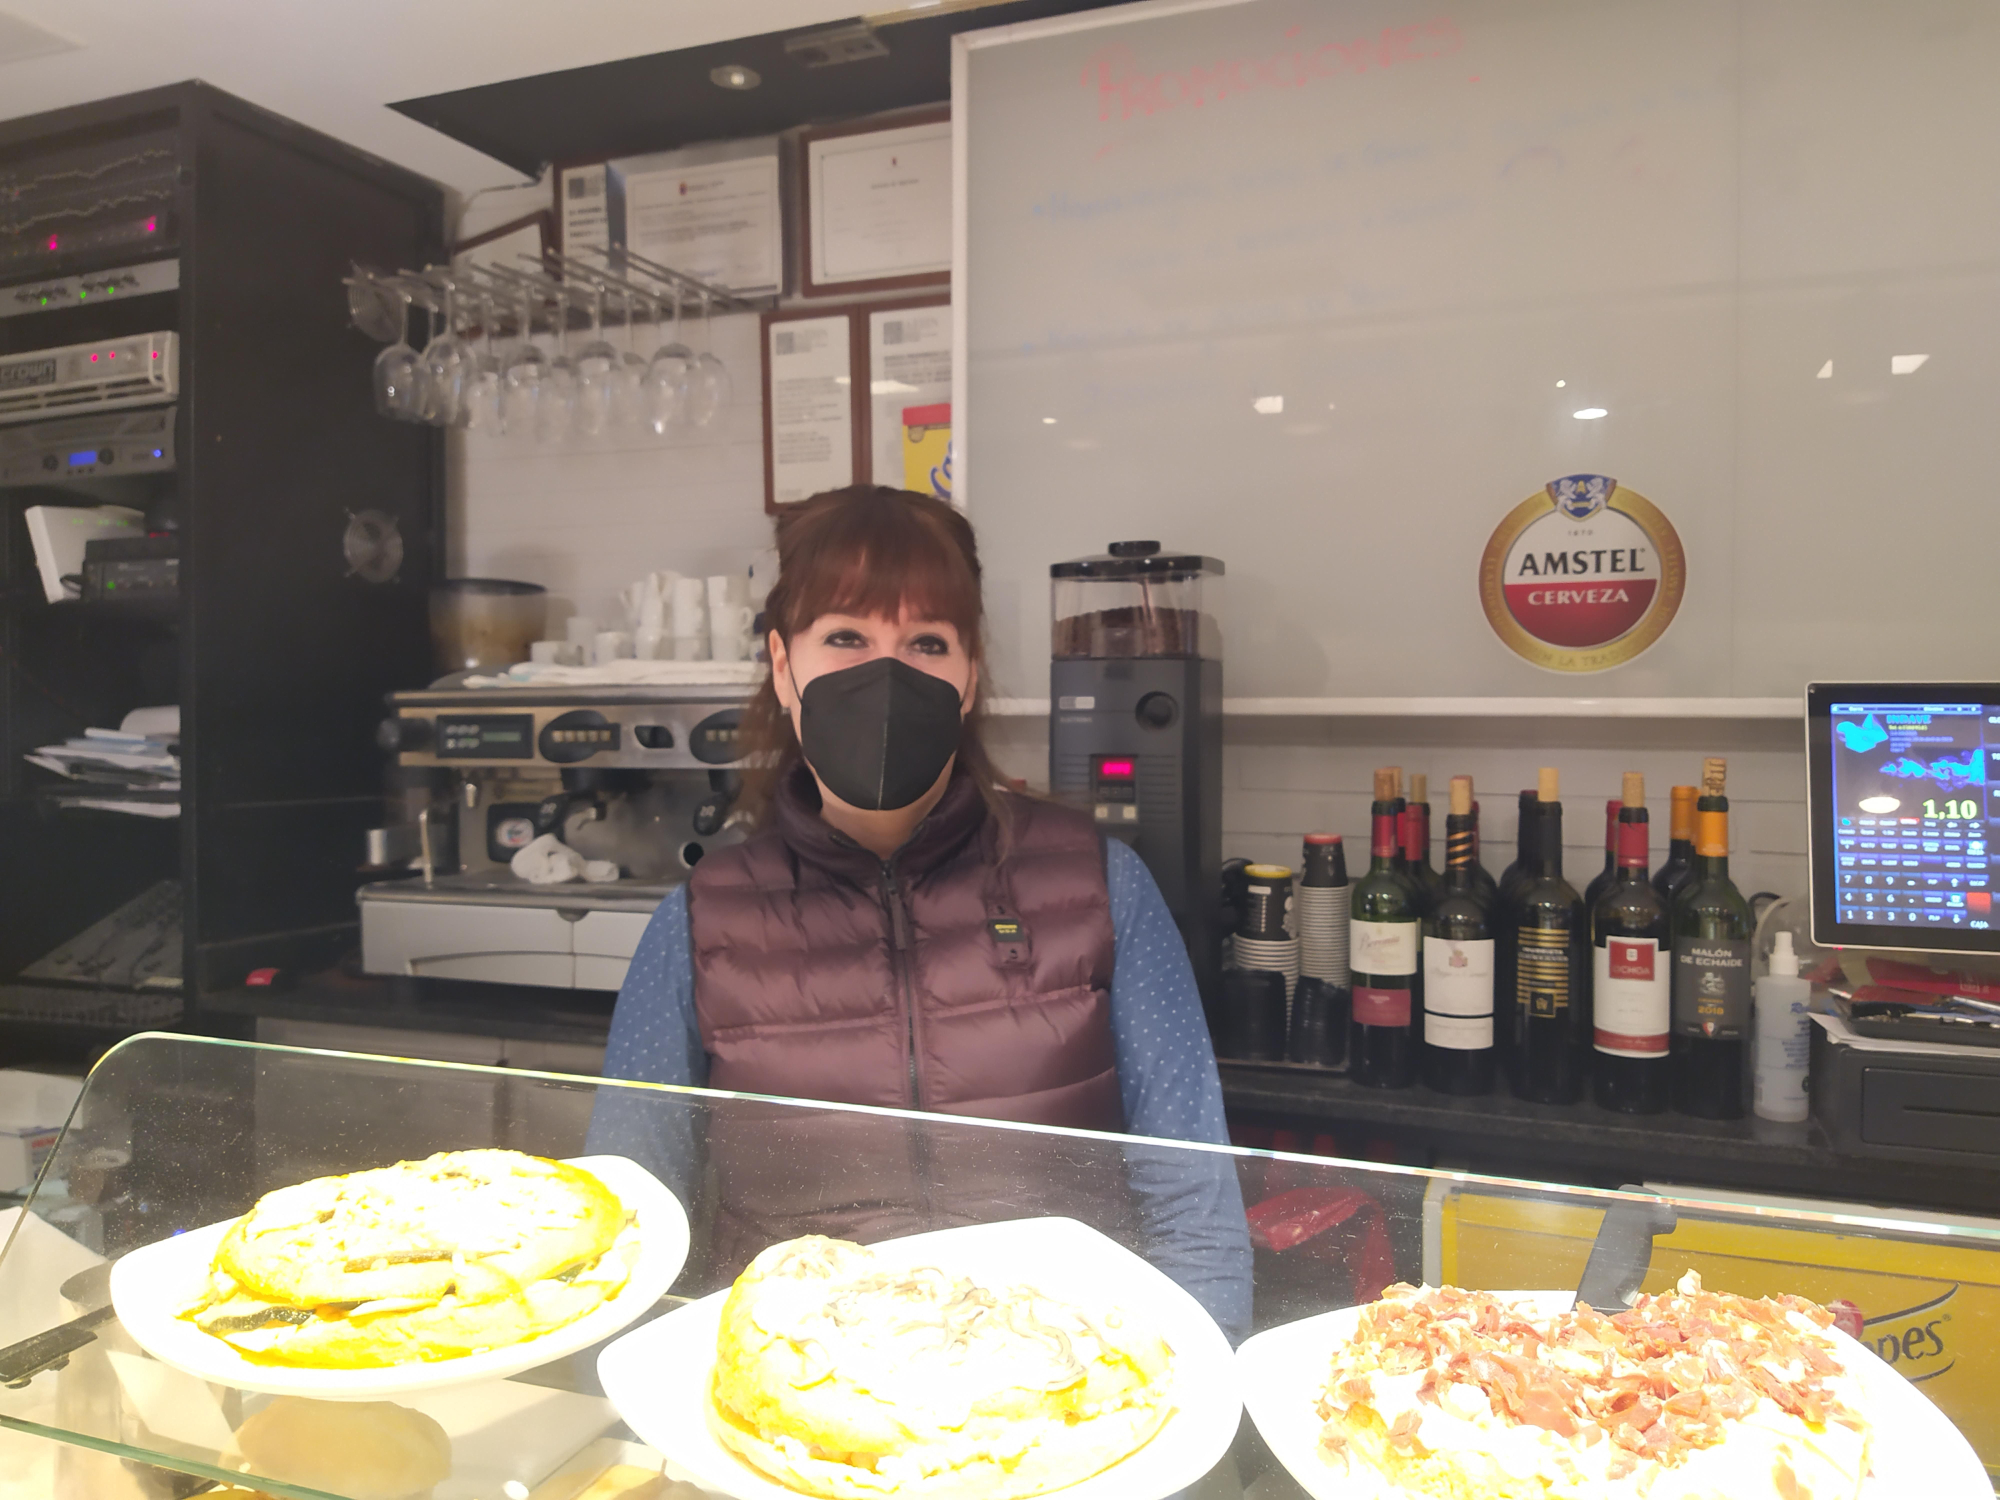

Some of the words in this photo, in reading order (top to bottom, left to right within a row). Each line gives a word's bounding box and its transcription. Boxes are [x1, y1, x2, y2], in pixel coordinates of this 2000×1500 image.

[1518, 548, 1645, 577] AMSTEL
[1528, 588, 1629, 606] CERVEZA
[1923, 799, 1977, 820] 1,10
[1691, 948, 1732, 958] MALÓN
[1695, 957, 1744, 968] ECHAIDE
